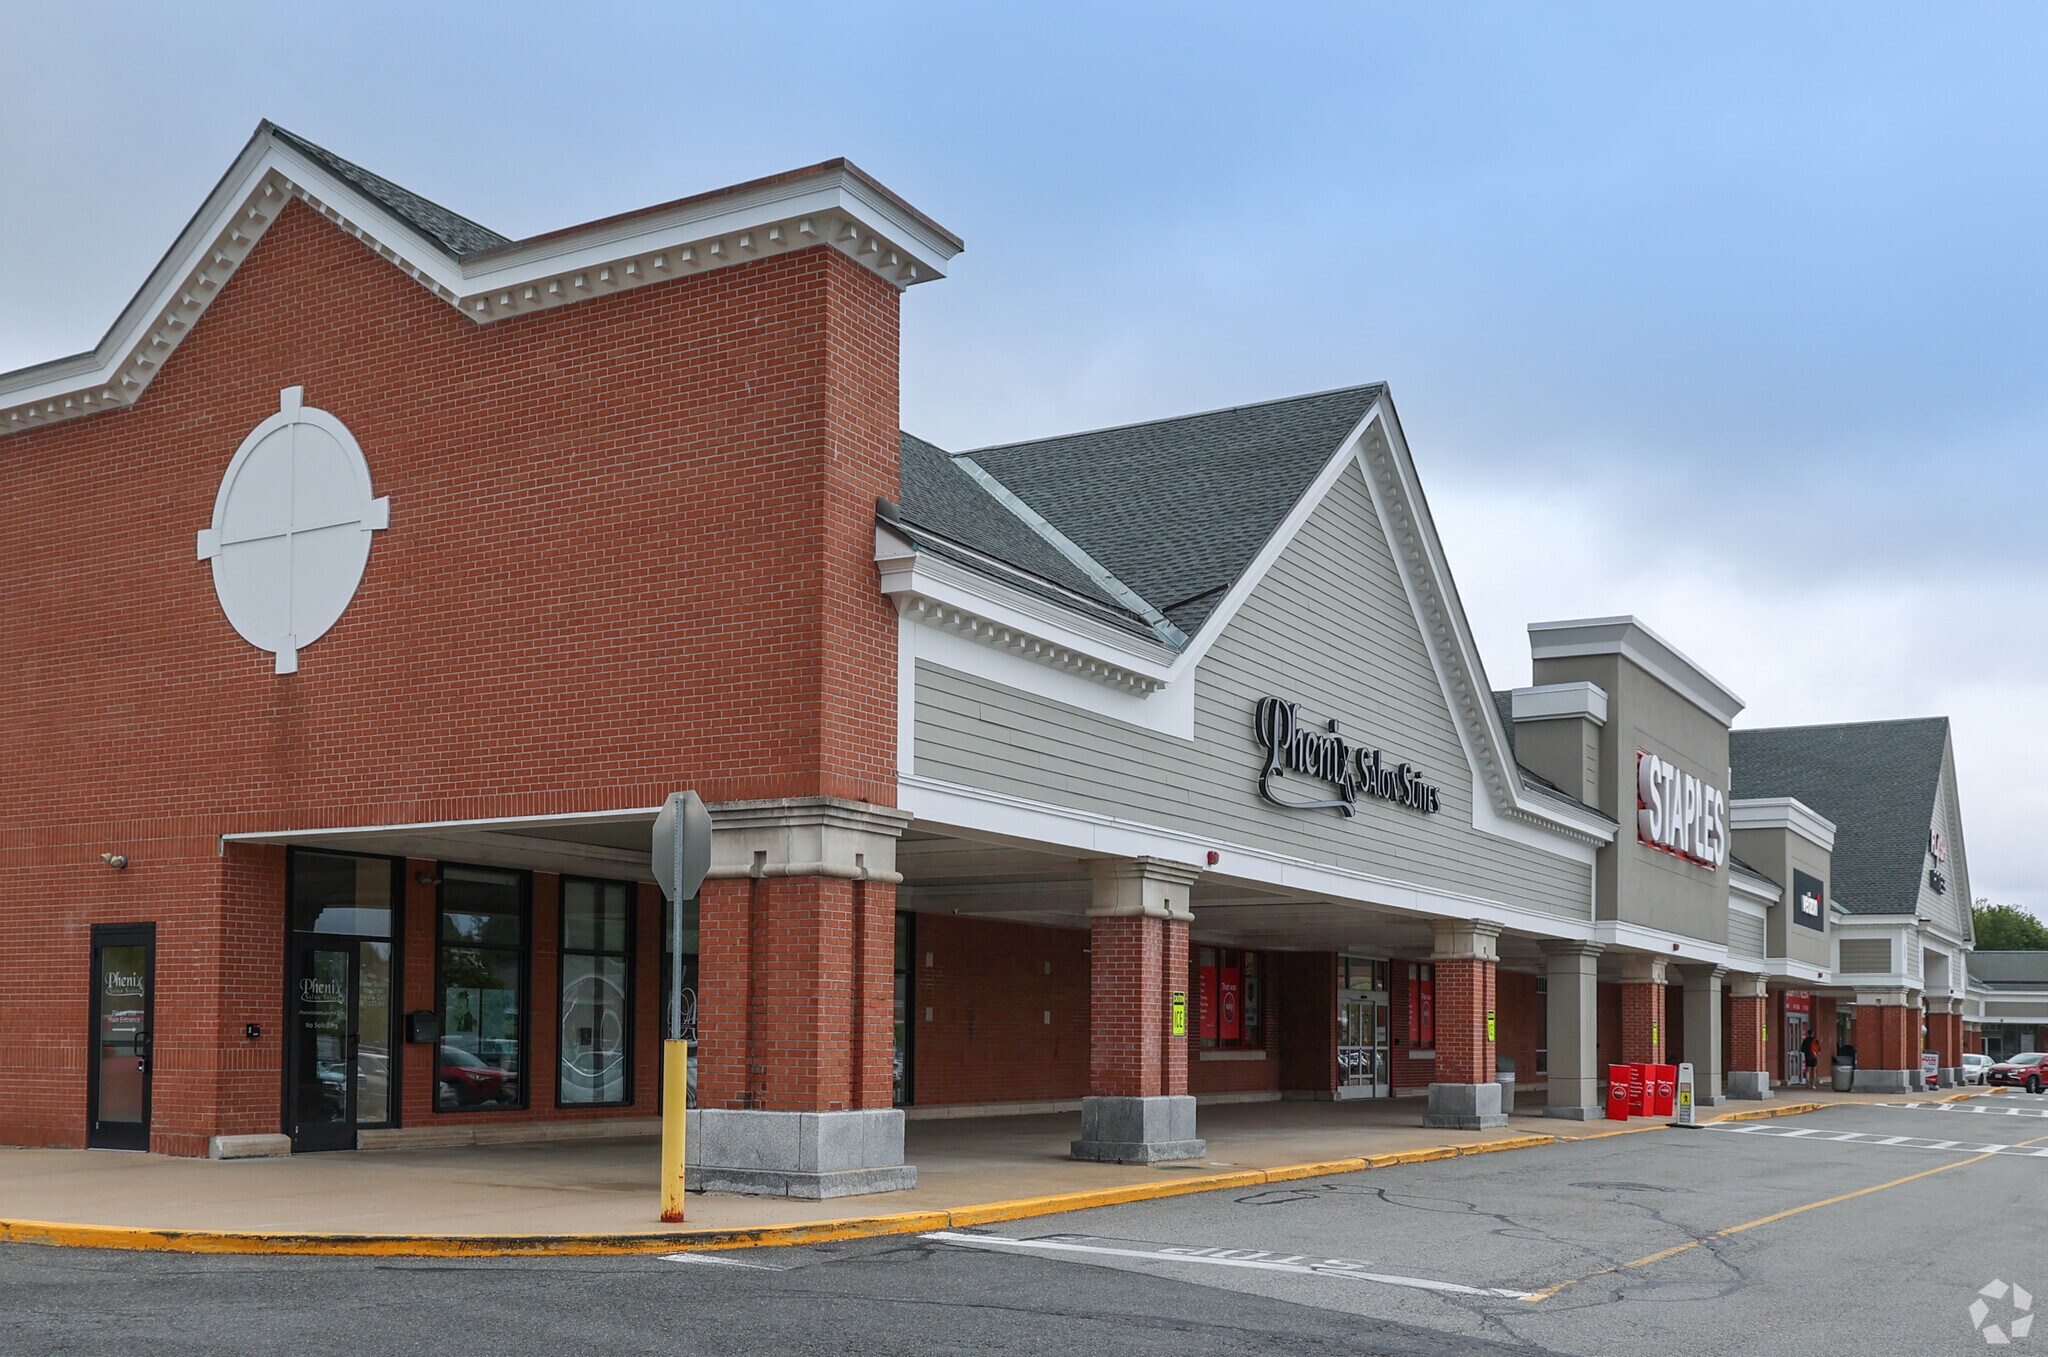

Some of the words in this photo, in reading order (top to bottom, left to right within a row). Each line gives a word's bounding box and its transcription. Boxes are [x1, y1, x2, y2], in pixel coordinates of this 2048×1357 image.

[1254, 696, 1356, 817] Phenix
[1639, 754, 1725, 866] STAPLES
[105, 971, 144, 995] Phenix
[299, 977, 344, 1001] Phenix
